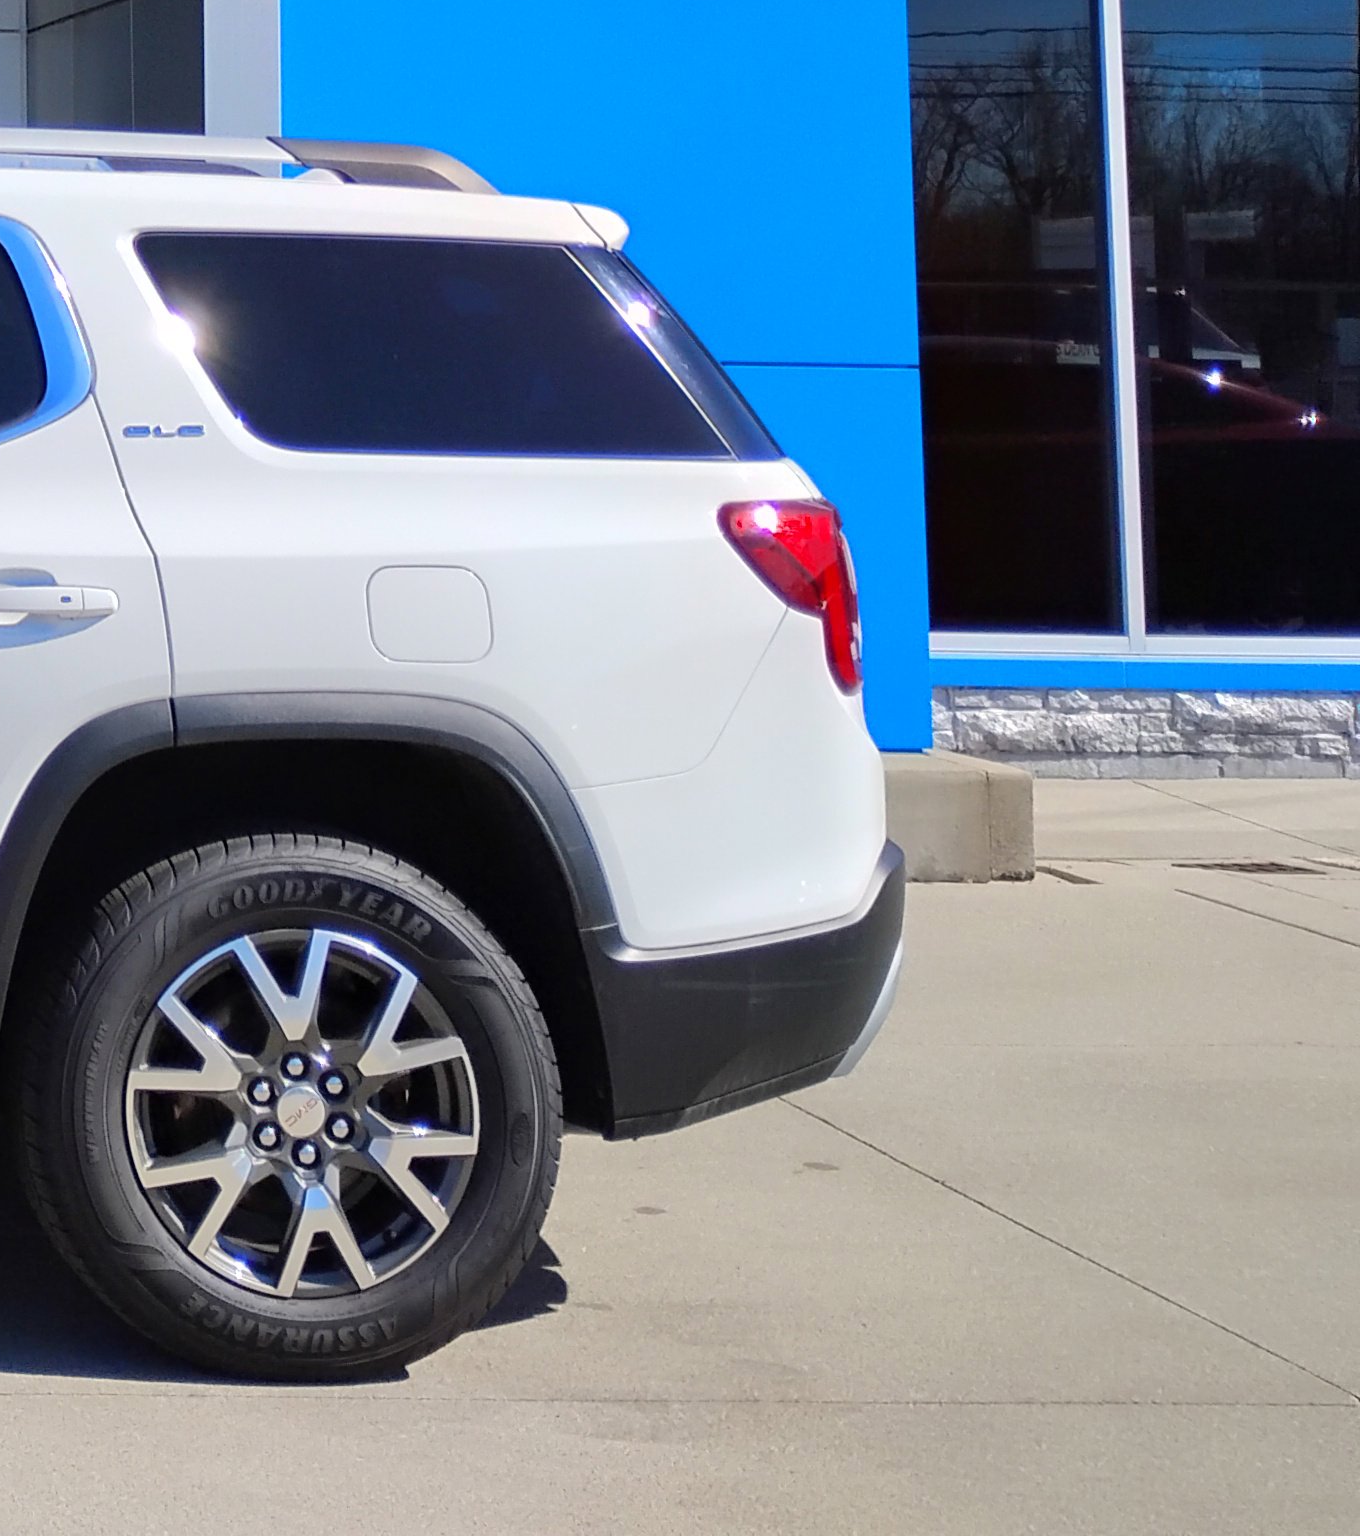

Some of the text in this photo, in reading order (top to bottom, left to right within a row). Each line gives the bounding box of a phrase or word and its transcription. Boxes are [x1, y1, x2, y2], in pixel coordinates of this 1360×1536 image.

[207, 878, 434, 942] GOODYEAR
[284, 1097, 319, 1128] GMC
[179, 1292, 399, 1355] ASSURANCE
